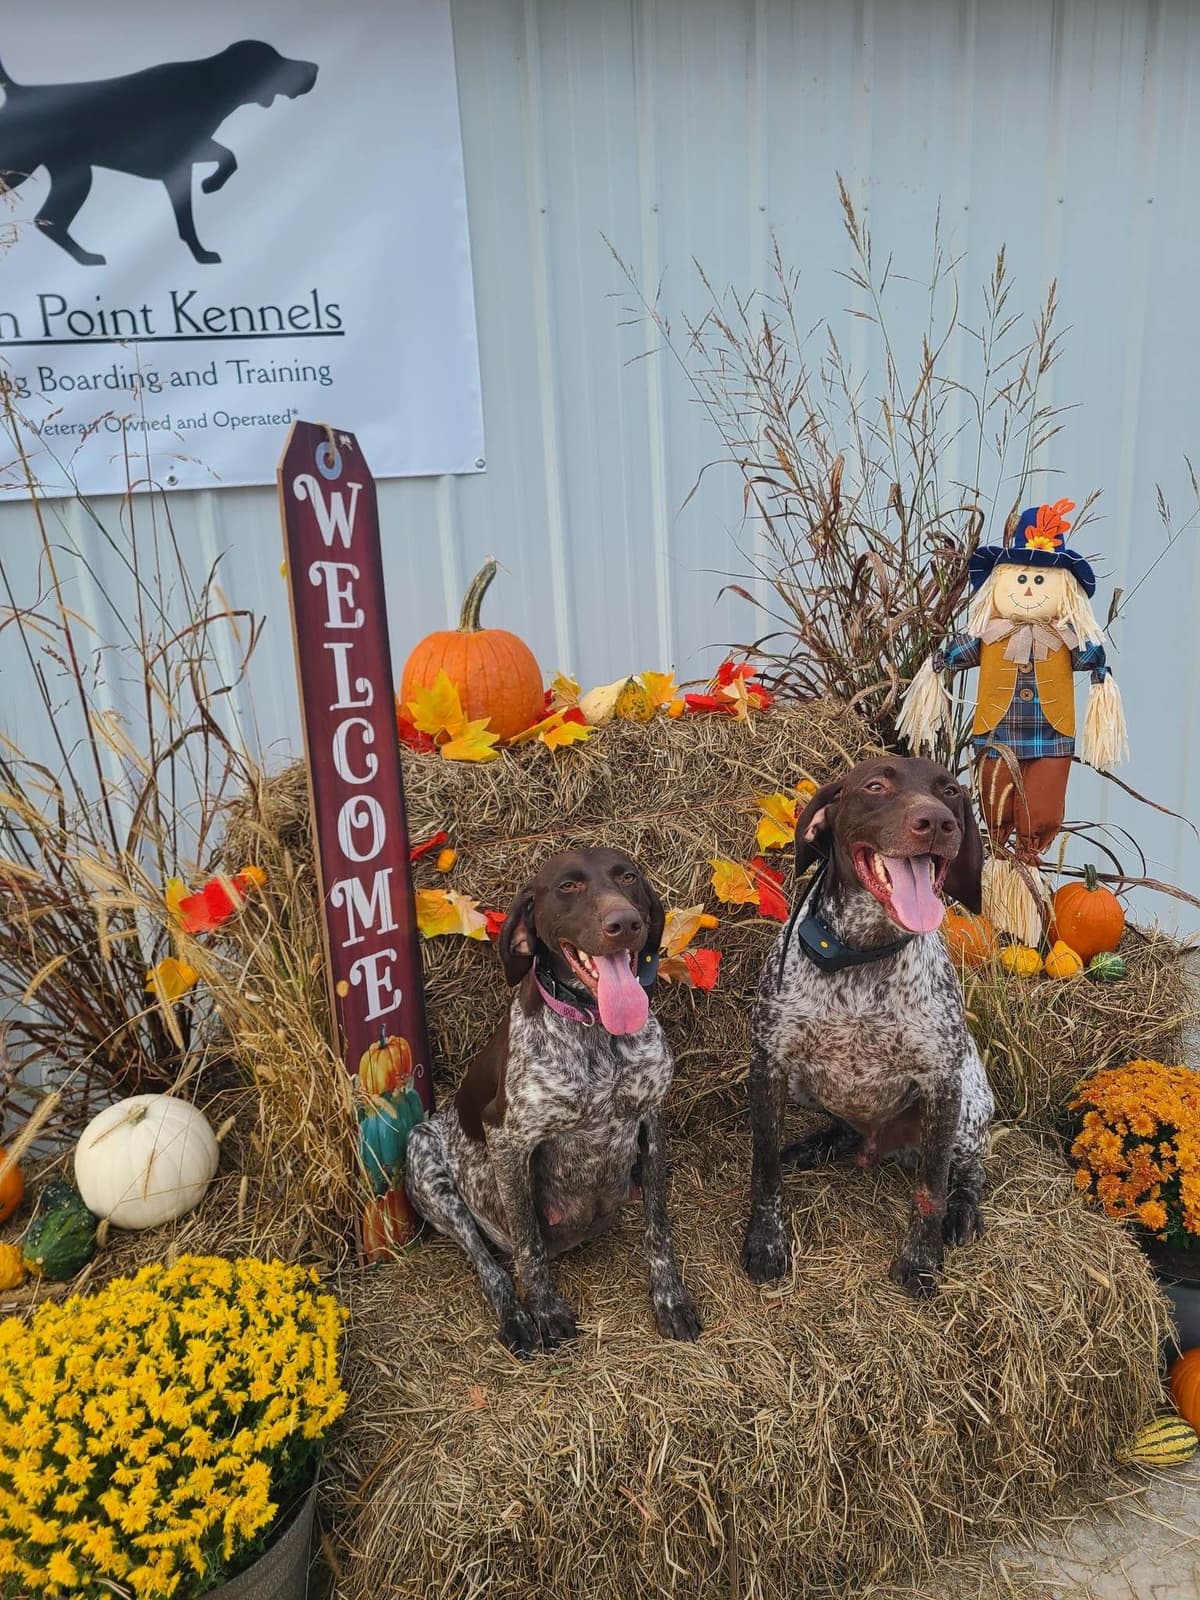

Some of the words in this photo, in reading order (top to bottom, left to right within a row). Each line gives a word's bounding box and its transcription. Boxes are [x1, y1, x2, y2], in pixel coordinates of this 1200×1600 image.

[37, 293, 156, 338] Point
[169, 288, 343, 334] Kennels
[37, 364, 163, 393] Boarding
[170, 361, 218, 388] and
[225, 358, 334, 387] Training
[104, 413, 171, 433] Owned
[177, 413, 208, 430] and
[293, 472, 402, 1023] WELCOME
